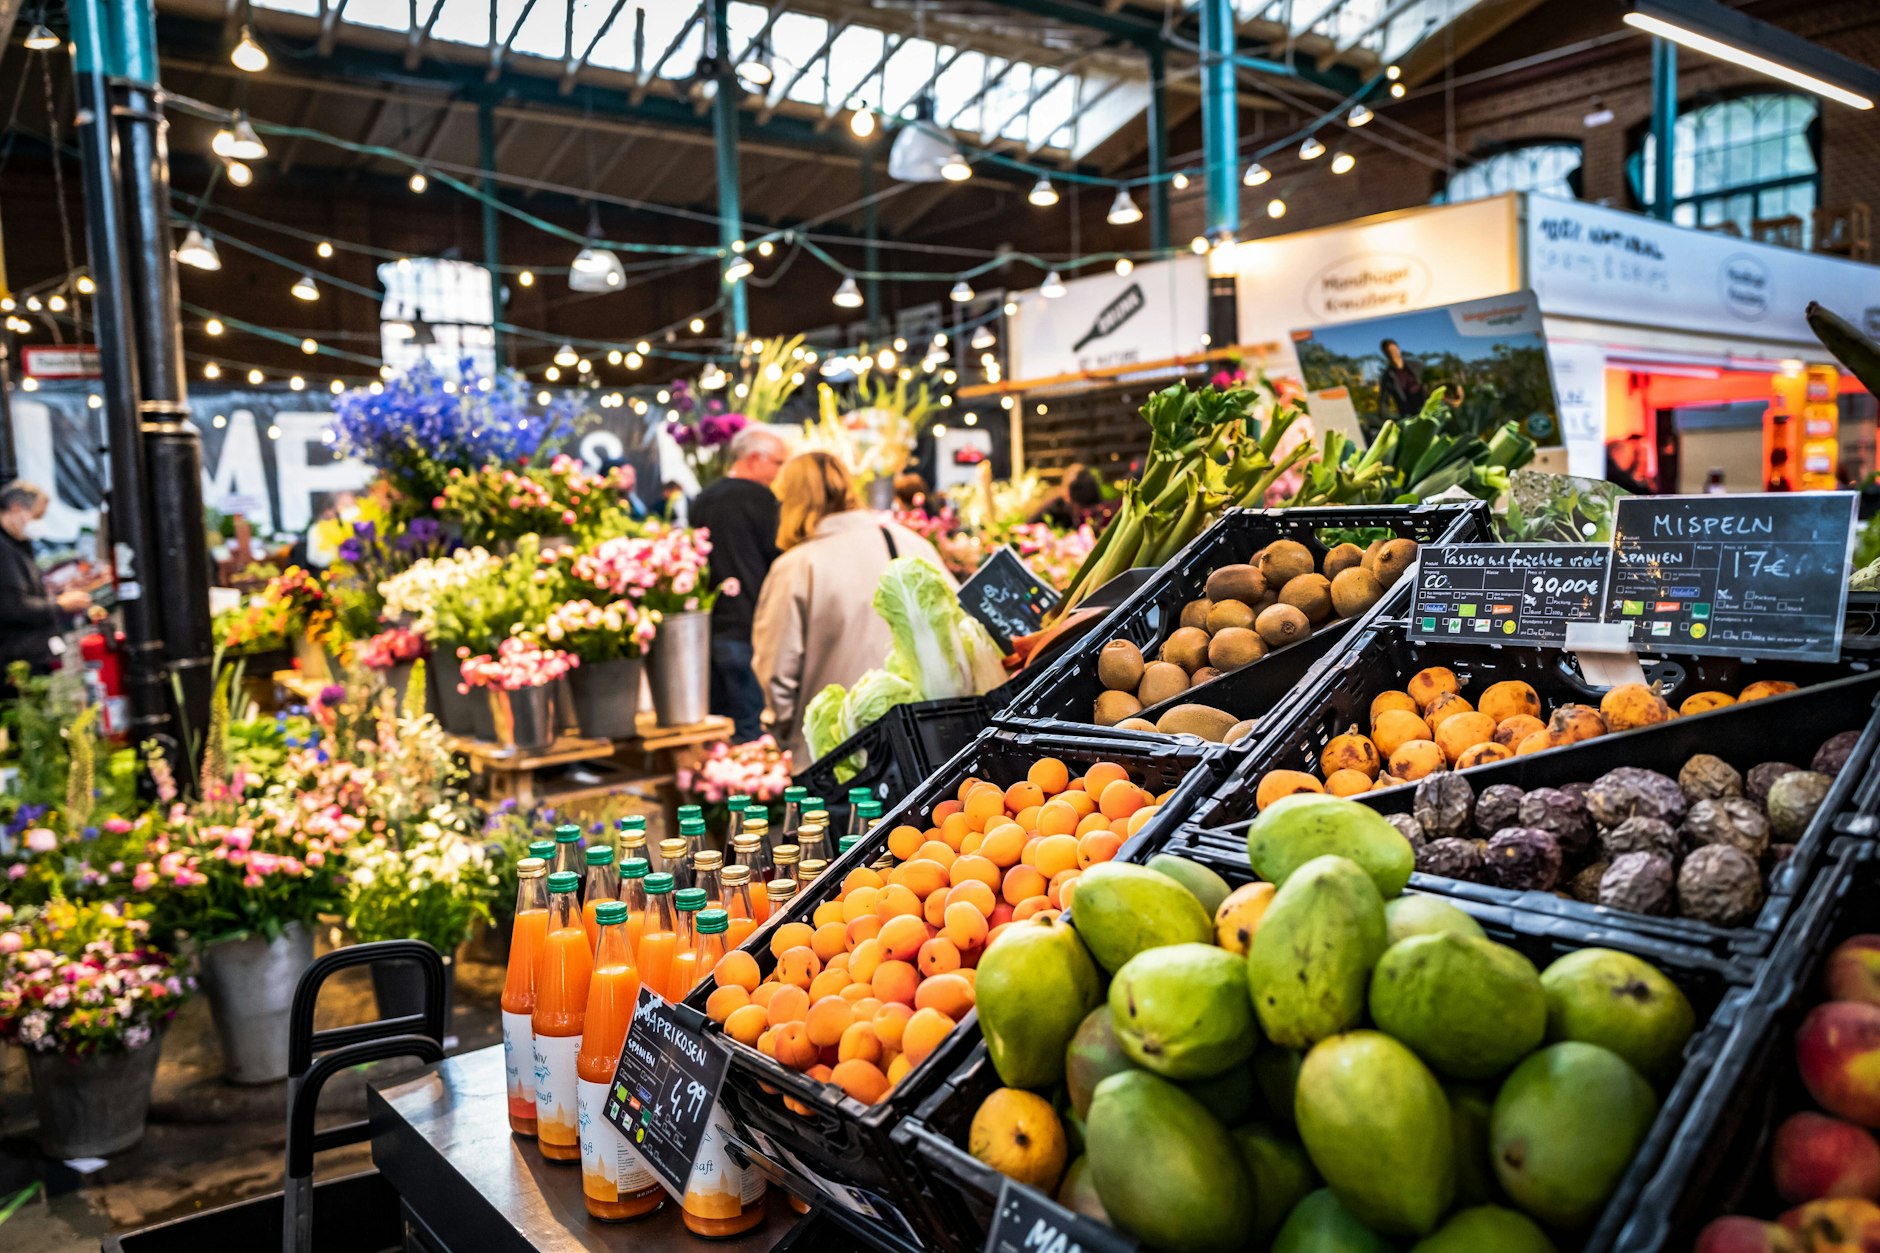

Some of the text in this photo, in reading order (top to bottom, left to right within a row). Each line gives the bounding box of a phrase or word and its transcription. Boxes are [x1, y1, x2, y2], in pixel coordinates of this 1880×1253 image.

[1653, 514, 1773, 537] MISPELN
[1620, 552, 1683, 564] SPANIEN
[1532, 576, 1599, 597] 20,00€
[647, 1012, 707, 1067] APRIKOSEN
[628, 1038, 656, 1068] SPANIEN
